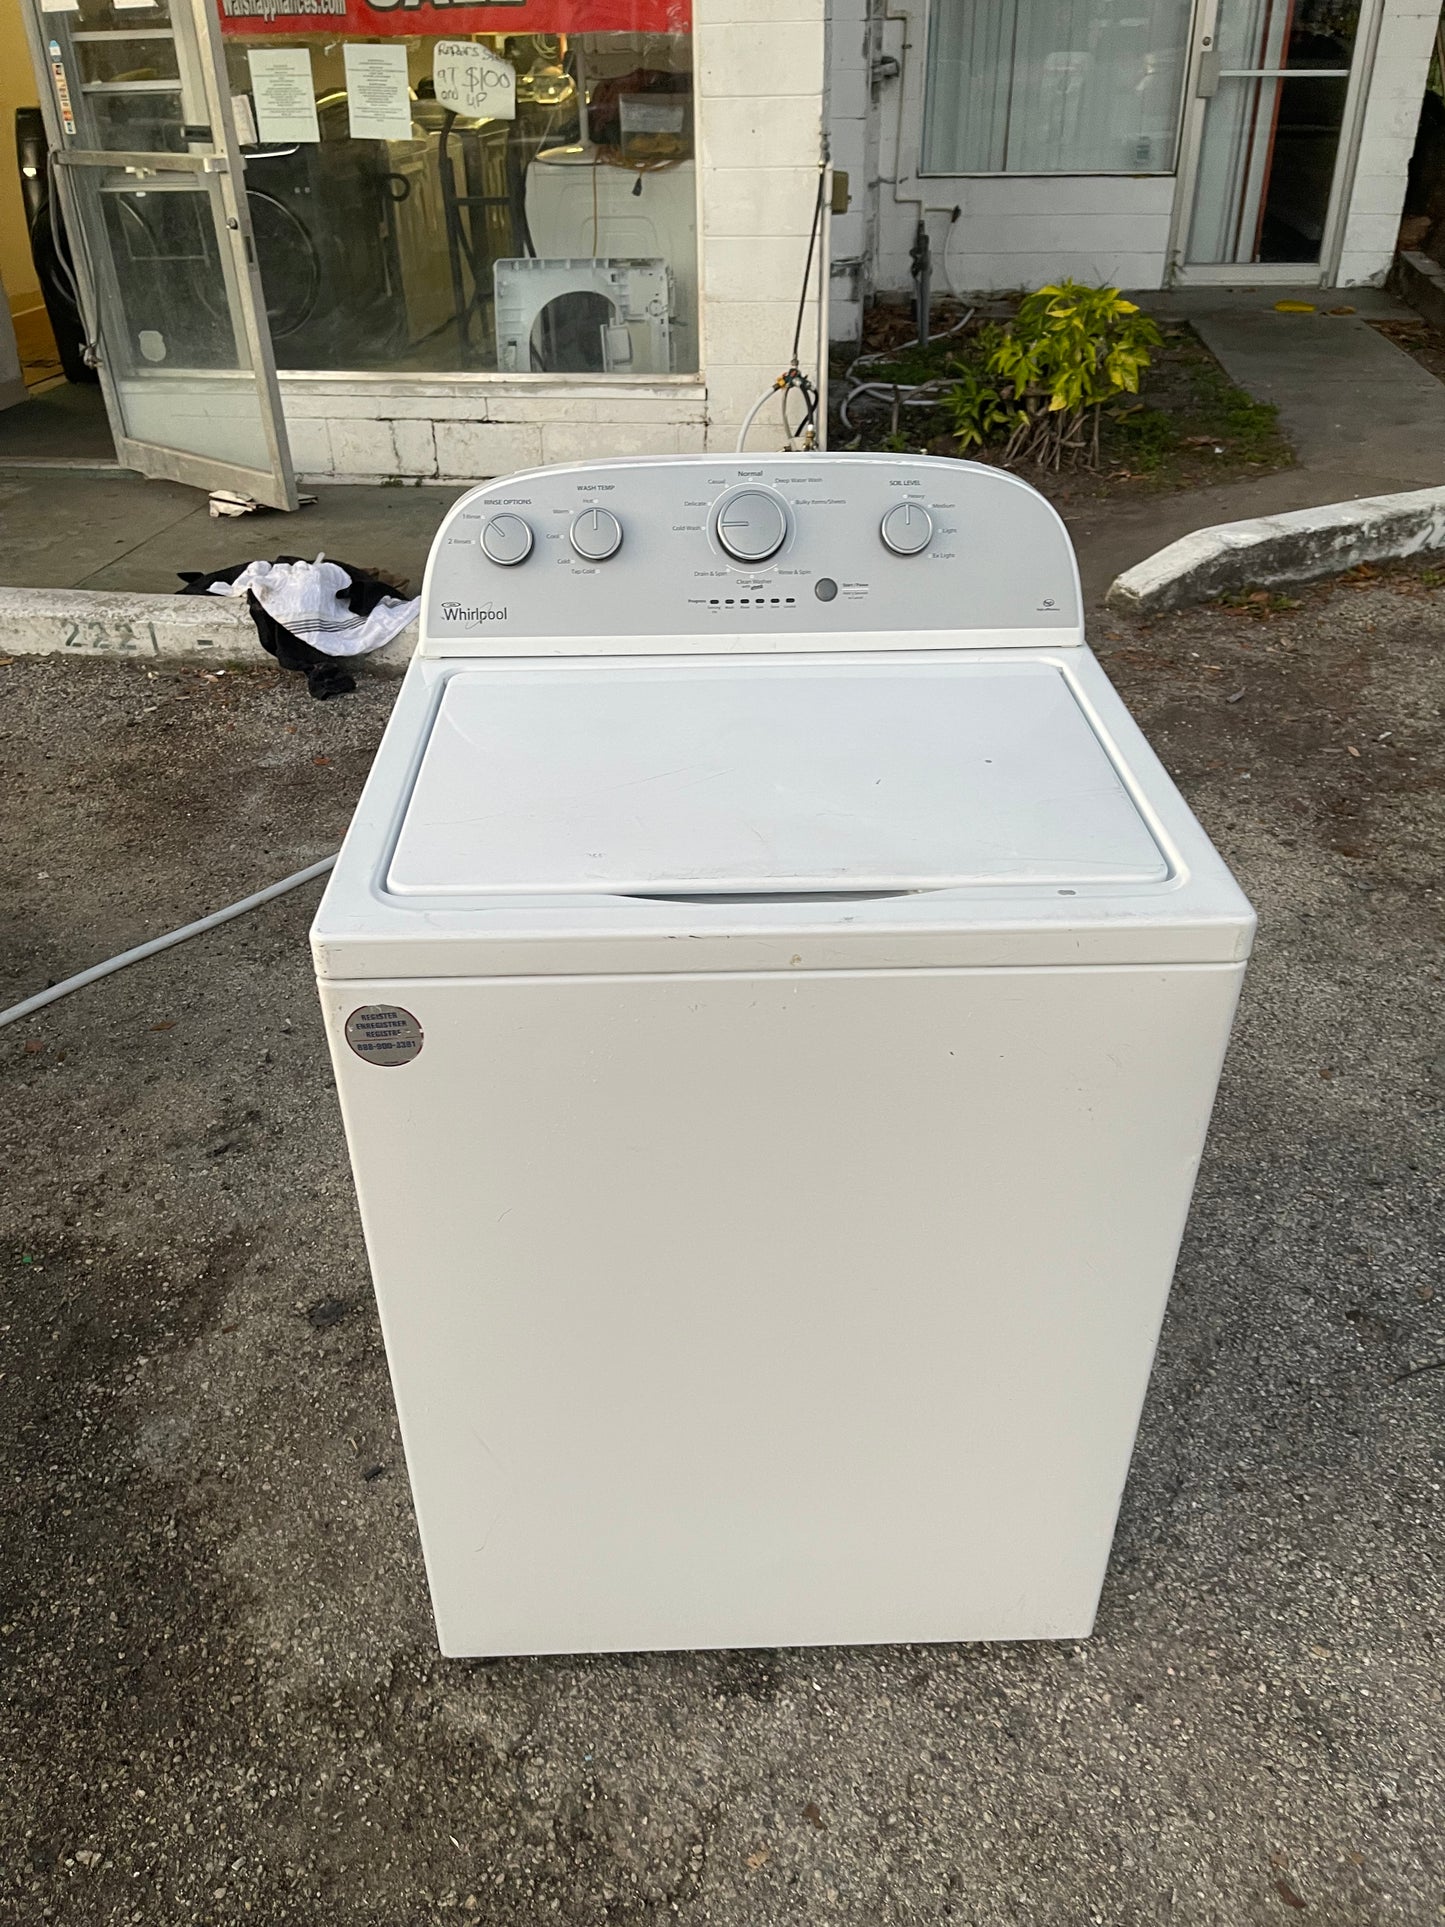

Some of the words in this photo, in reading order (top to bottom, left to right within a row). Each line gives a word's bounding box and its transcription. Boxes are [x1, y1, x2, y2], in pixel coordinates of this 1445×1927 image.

[461, 66, 511, 93] $100
[503, 498, 532, 506] OPTIONS
[443, 606, 508, 625] Whirlpool
[60, 620, 159, 657] 2221
[360, 1011, 398, 1021] REGISTER
[355, 1020, 408, 1030] ENREGISTRER
